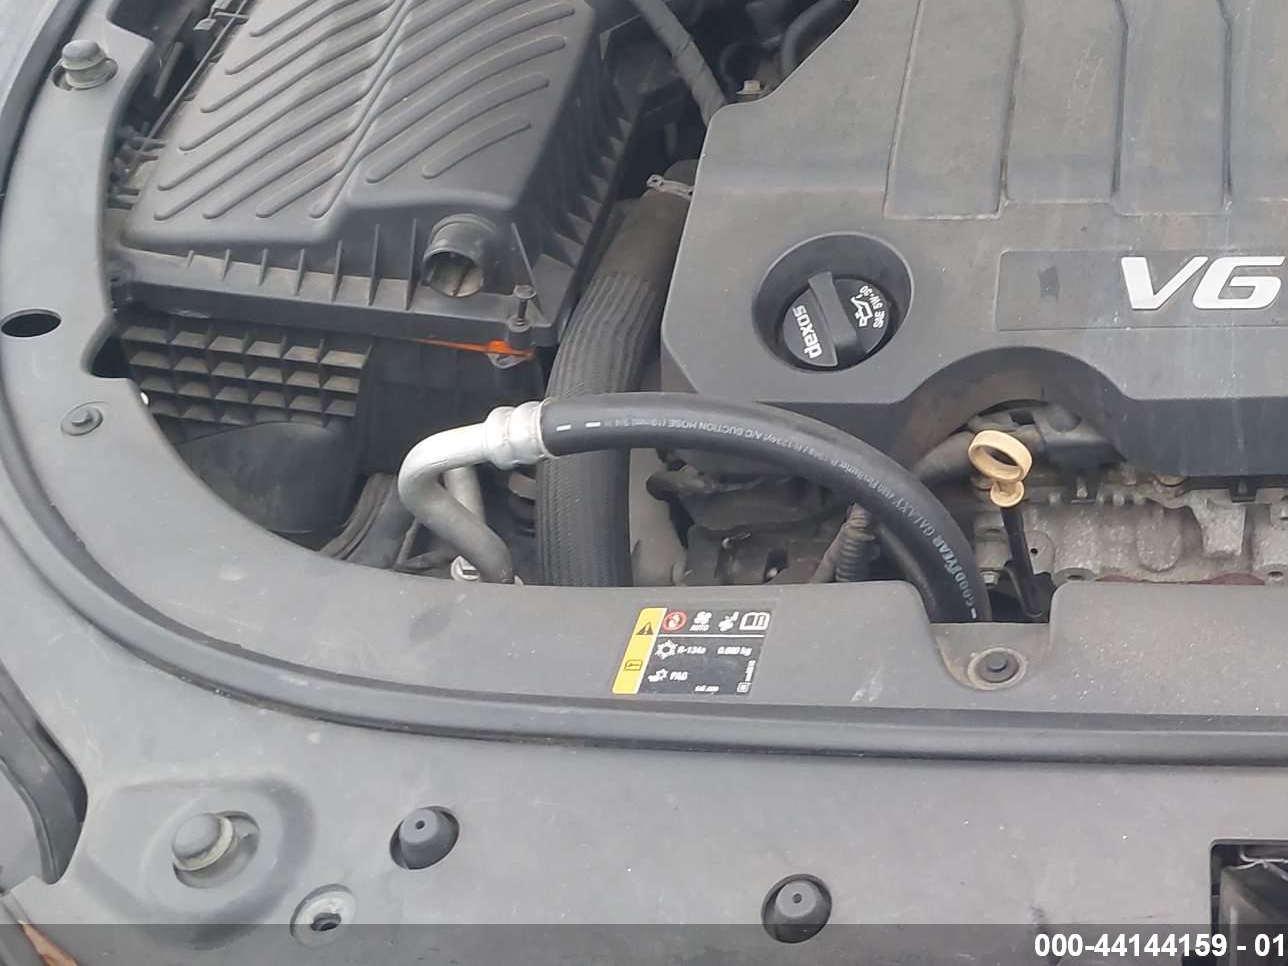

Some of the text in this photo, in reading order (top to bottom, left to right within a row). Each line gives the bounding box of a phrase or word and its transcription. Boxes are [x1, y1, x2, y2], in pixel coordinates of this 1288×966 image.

[1120, 255, 1287, 311] V6
[792, 305, 823, 359] dexos
[872, 310, 886, 329] SAE
[667, 418, 698, 429] HOSE
[698, 420, 744, 436] SUCTION
[891, 494, 936, 538] GALAXY
[930, 534, 978, 607] GOODYEAR
